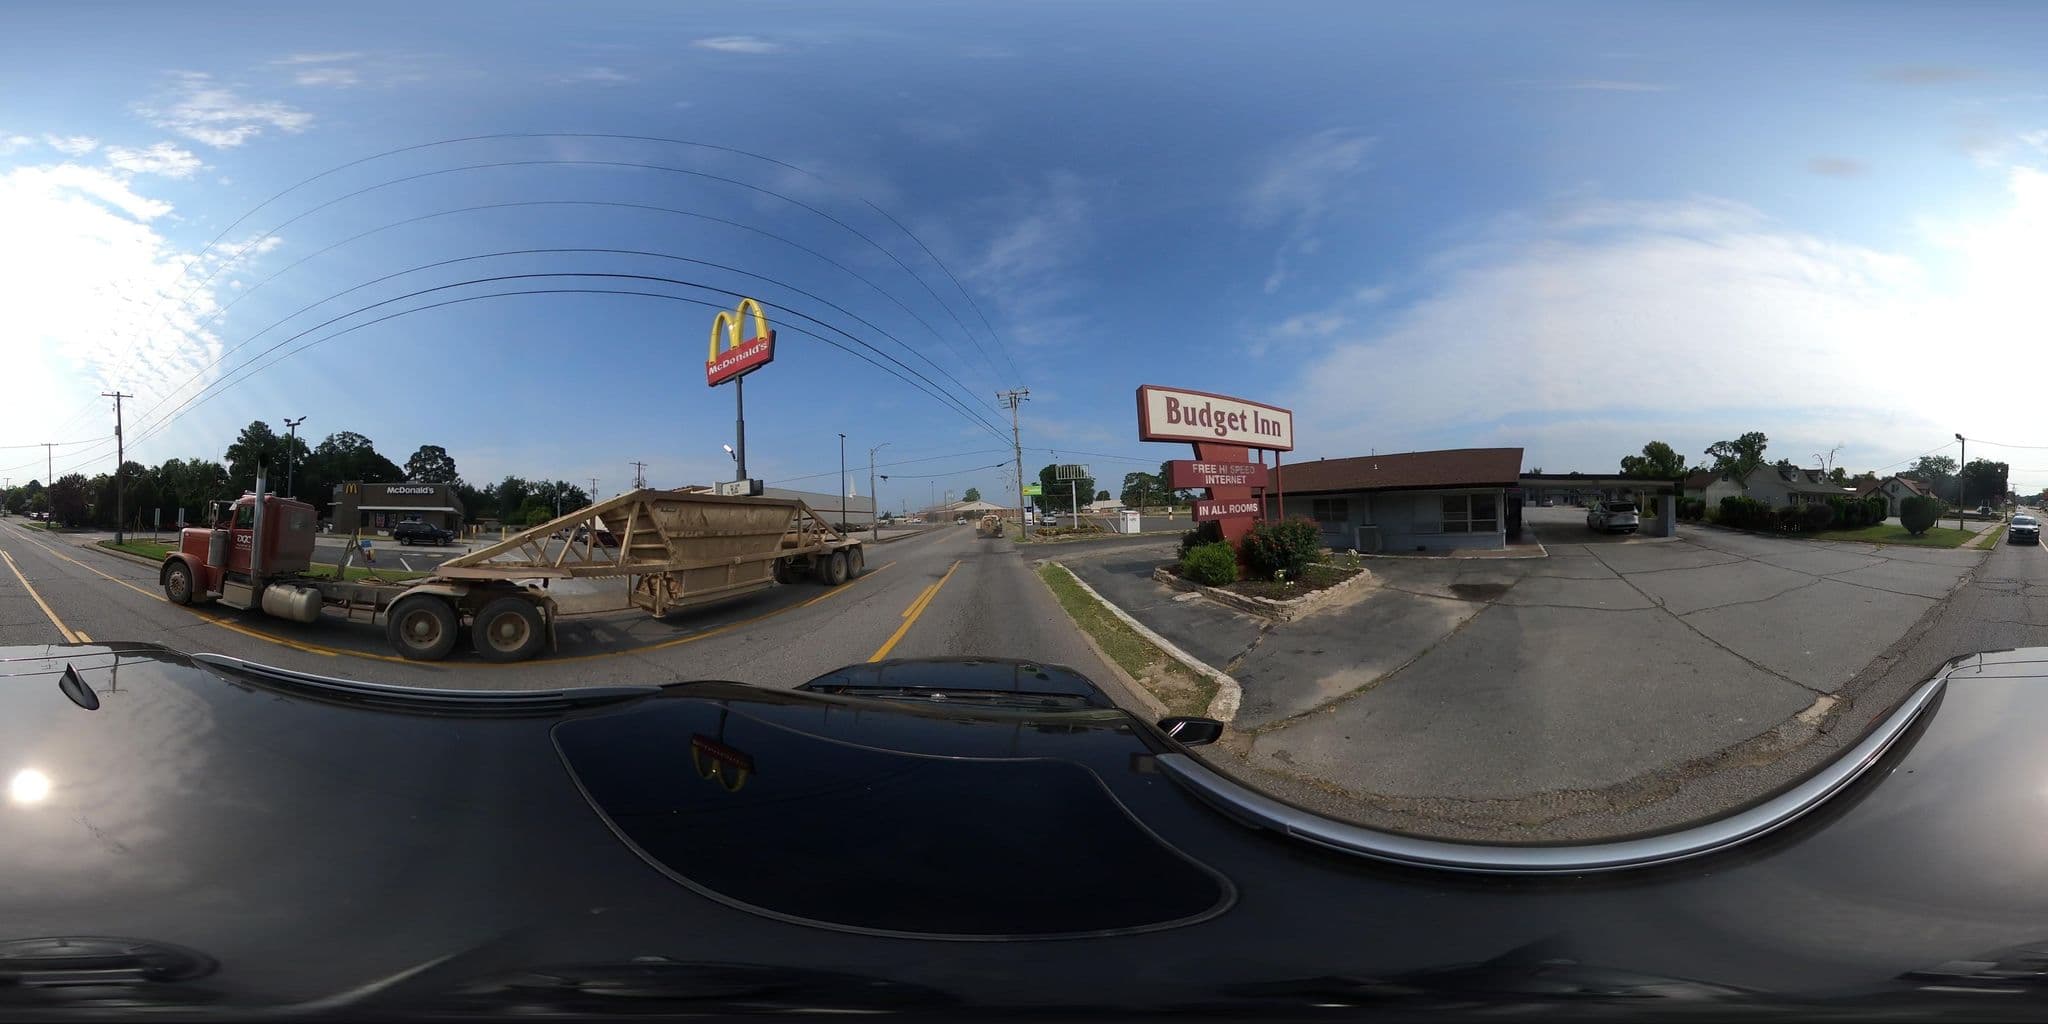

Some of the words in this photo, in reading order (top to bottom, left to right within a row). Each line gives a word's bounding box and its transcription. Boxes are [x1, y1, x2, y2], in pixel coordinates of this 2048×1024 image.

[708, 341, 769, 376] McDonald's
[1165, 396, 1248, 437] Budget
[1253, 410, 1282, 437] Inn
[1192, 463, 1217, 474] FREE
[1219, 464, 1228, 474] HI
[1230, 465, 1255, 474] SPEED
[1205, 475, 1247, 484] INTERNET
[386, 486, 434, 494] McDonald's
[1199, 506, 1209, 516] IN
[1211, 505, 1227, 515] ALL
[1229, 503, 1258, 513] ROOMS
